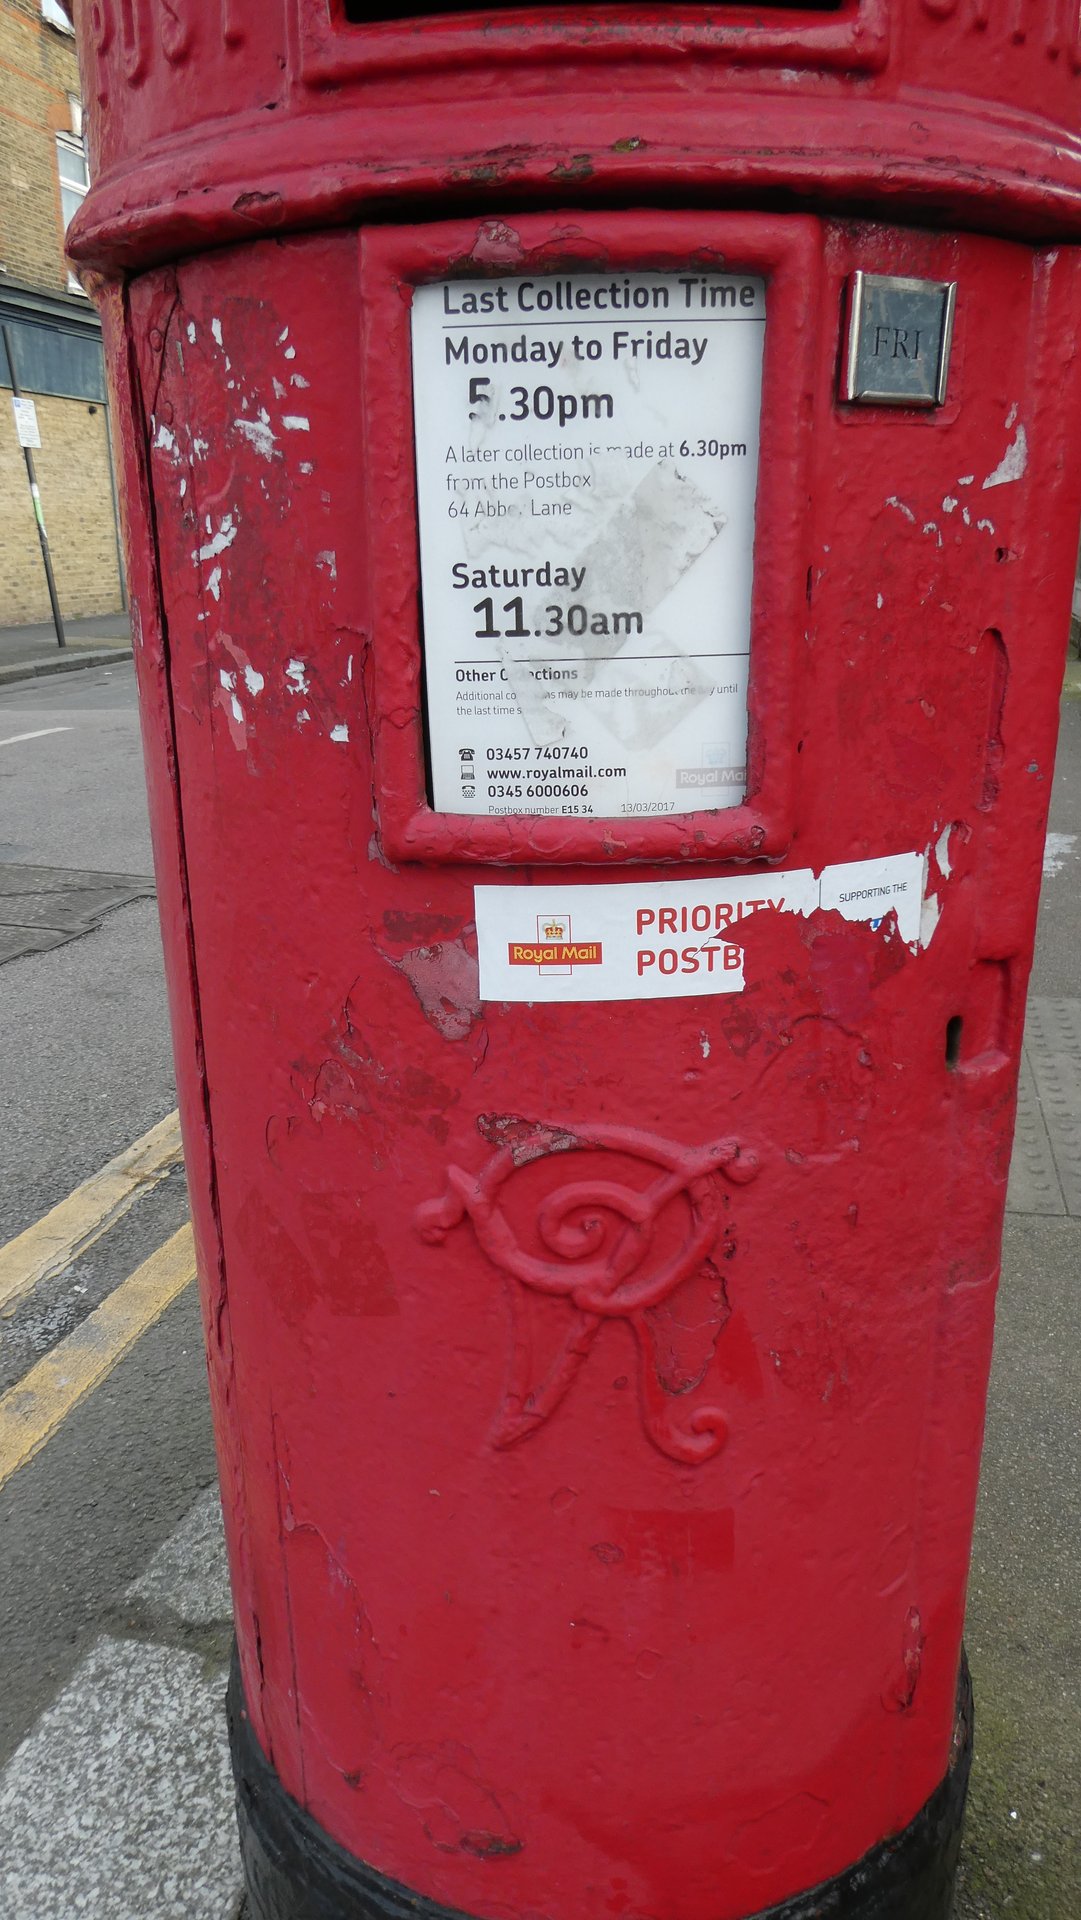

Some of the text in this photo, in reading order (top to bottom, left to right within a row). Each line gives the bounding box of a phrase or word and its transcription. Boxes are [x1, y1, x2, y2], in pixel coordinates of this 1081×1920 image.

[444, 277, 755, 315] Last Collection Time
[445, 330, 708, 369] Monday to Friday
[872, 326, 924, 360] FRI
[469, 377, 614, 428] 5.30pm
[445, 445, 458, 463] A
[461, 445, 501, 463] later
[504, 443, 584, 462] collection
[657, 441, 675, 458] at
[679, 439, 748, 460] 6.30pm
[492, 472, 519, 490] the
[524, 471, 592, 489] Postbox
[447, 501, 470, 518] 64
[531, 499, 573, 516] Lane
[452, 561, 587, 592] Saturday
[473, 596, 644, 639] 11.30am
[455, 668, 497, 682] Other
[455, 690, 503, 701] Additional
[558, 689, 579, 701] may
[581, 687, 594, 699] be
[595, 686, 622, 698] made
[717, 683, 739, 694] until
[456, 706, 473, 716] the
[474, 705, 492, 716] last
[493, 705, 515, 716] time
[486, 746, 589, 761] 03457 740740
[487, 765, 627, 782] www.royalmail.com
[680, 768, 747, 786] Royal Mai
[488, 784, 589, 798] 0345 6000606
[488, 801, 676, 815] Postbox number E15 34 13/03/2017
[839, 881, 908, 903] SUPPORTING THE
[512, 945, 597, 964] Royal Mail
